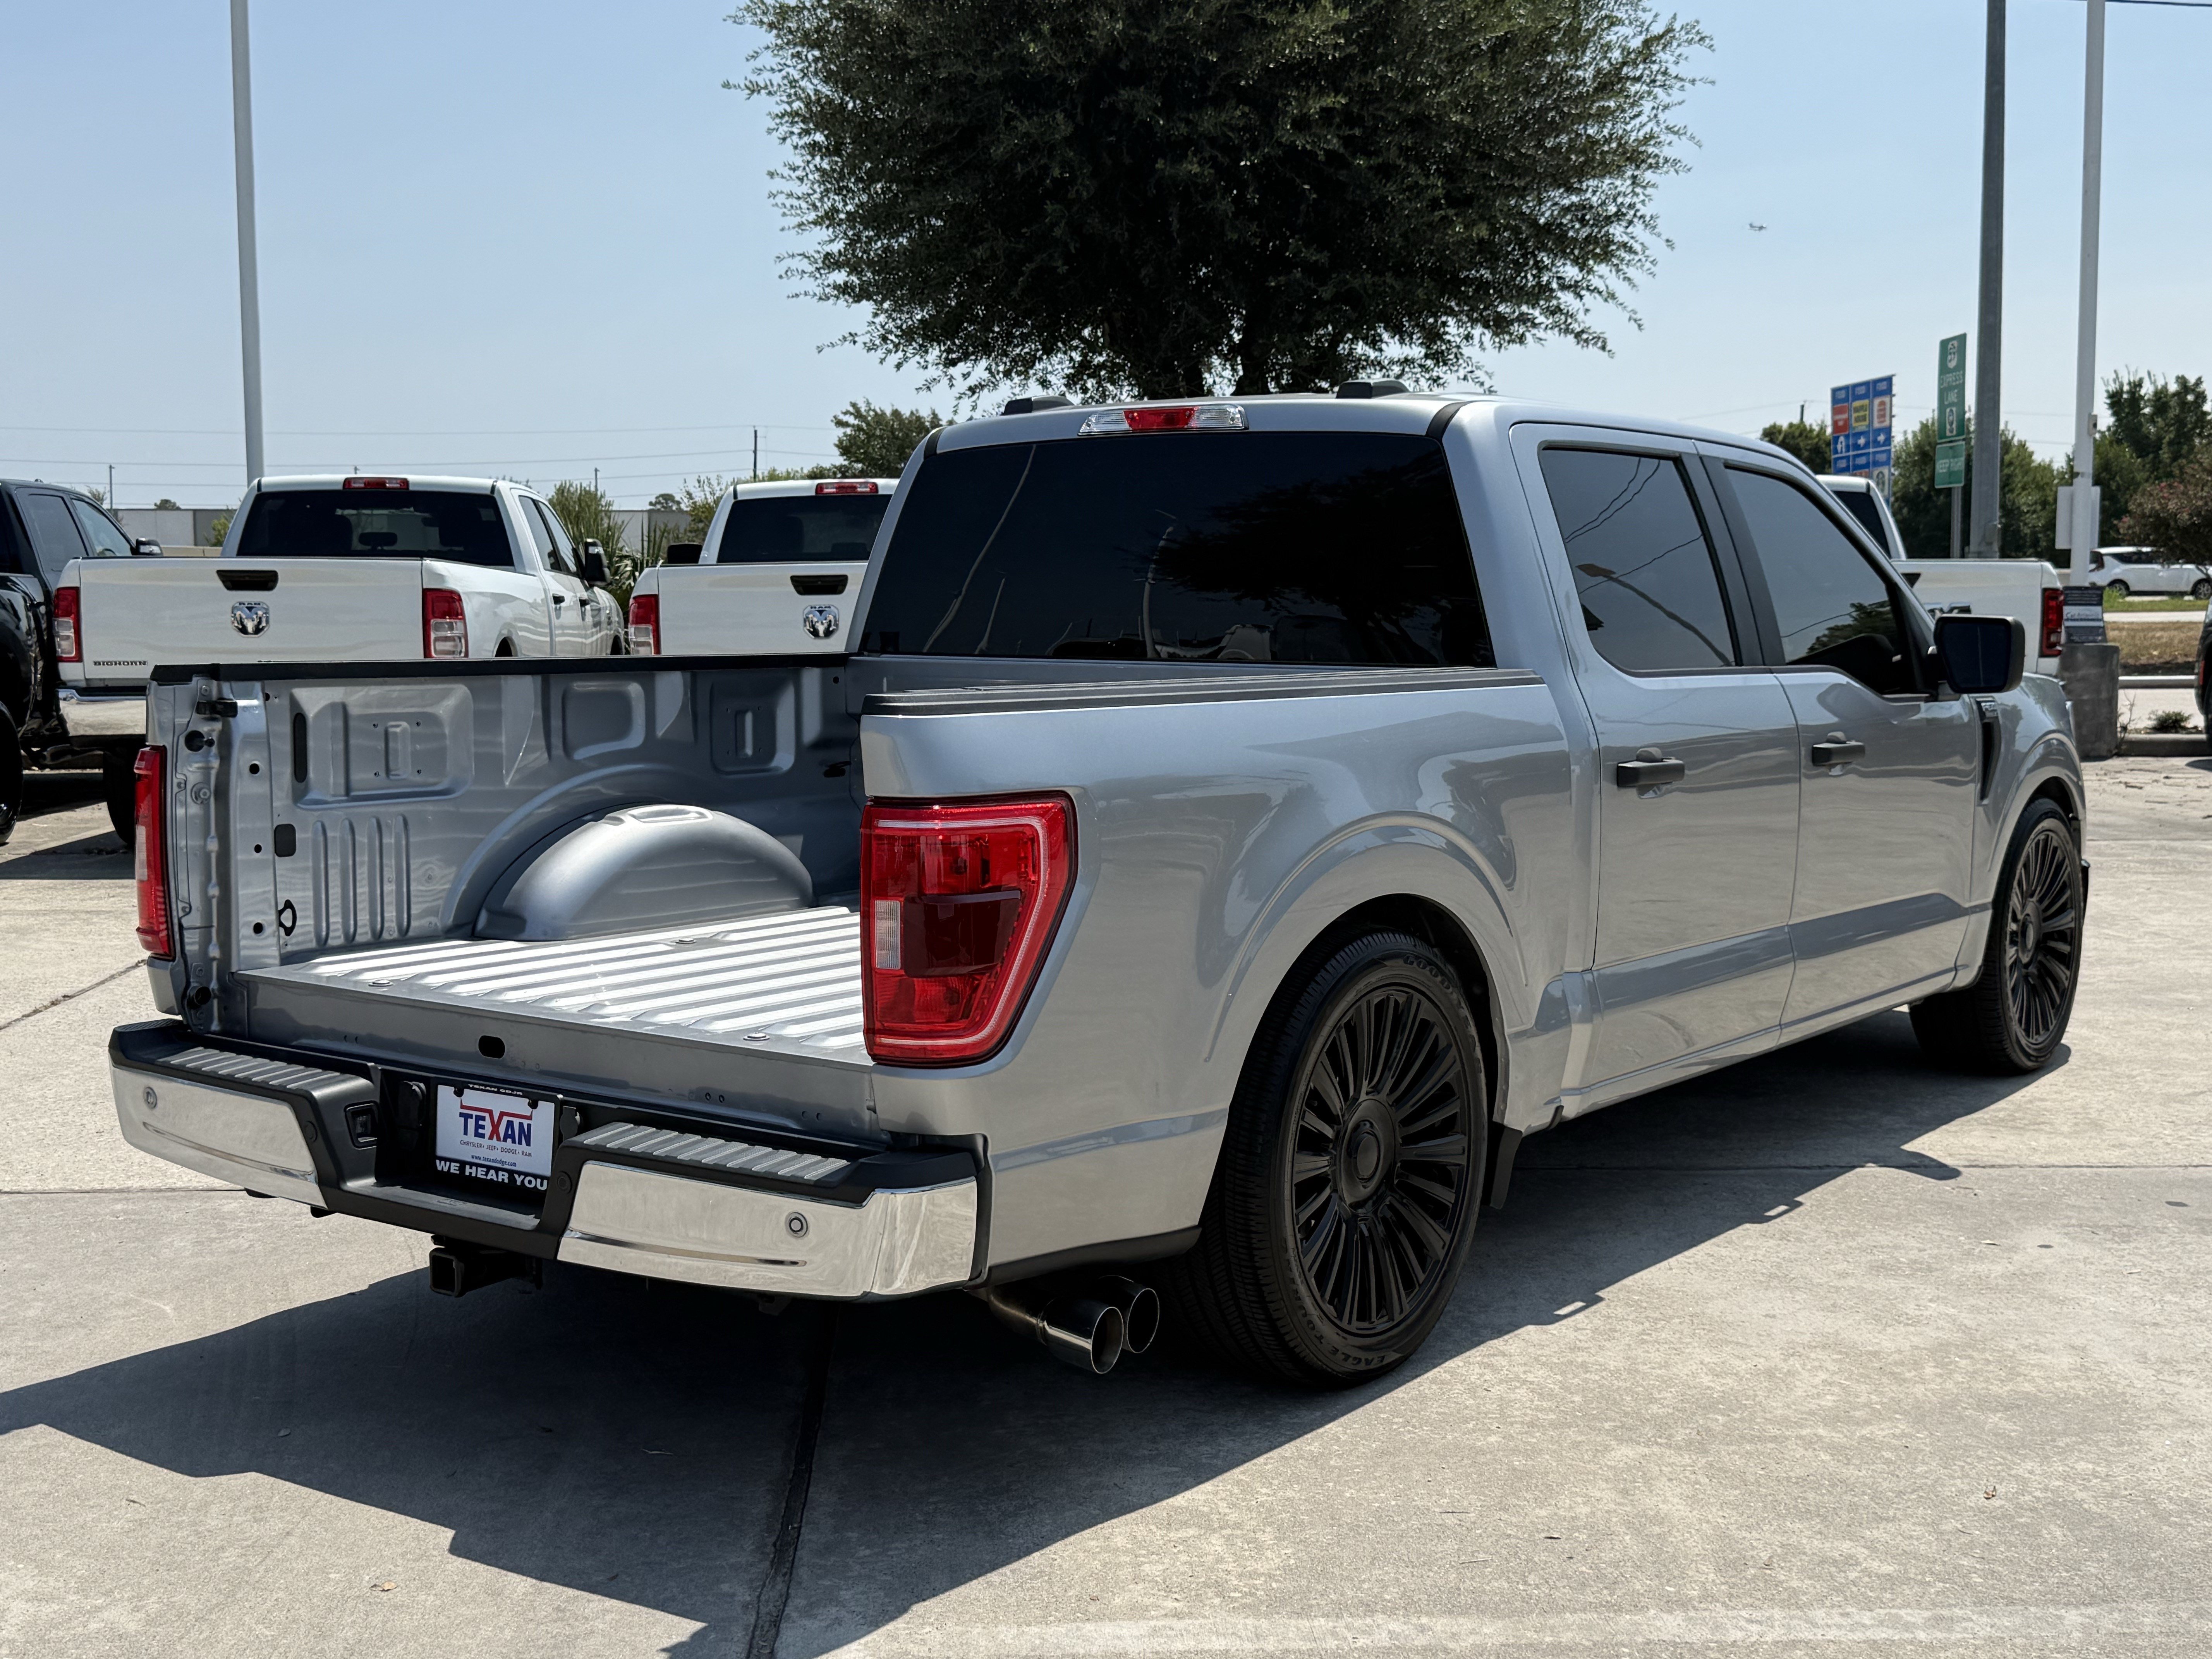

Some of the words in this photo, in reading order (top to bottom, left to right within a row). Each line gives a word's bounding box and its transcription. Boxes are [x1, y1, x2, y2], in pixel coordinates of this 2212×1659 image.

[1940, 371, 1963, 388] EXPRESS
[1944, 389, 1958, 405] LANE
[459, 1098, 533, 1147] TEXAN
[471, 1154, 517, 1167] www.texandodge.com
[436, 1159, 460, 1174] WE
[465, 1164, 509, 1183] HEAR
[514, 1174, 548, 1190] YOU
[1327, 1345, 1386, 1366] EAGLE
